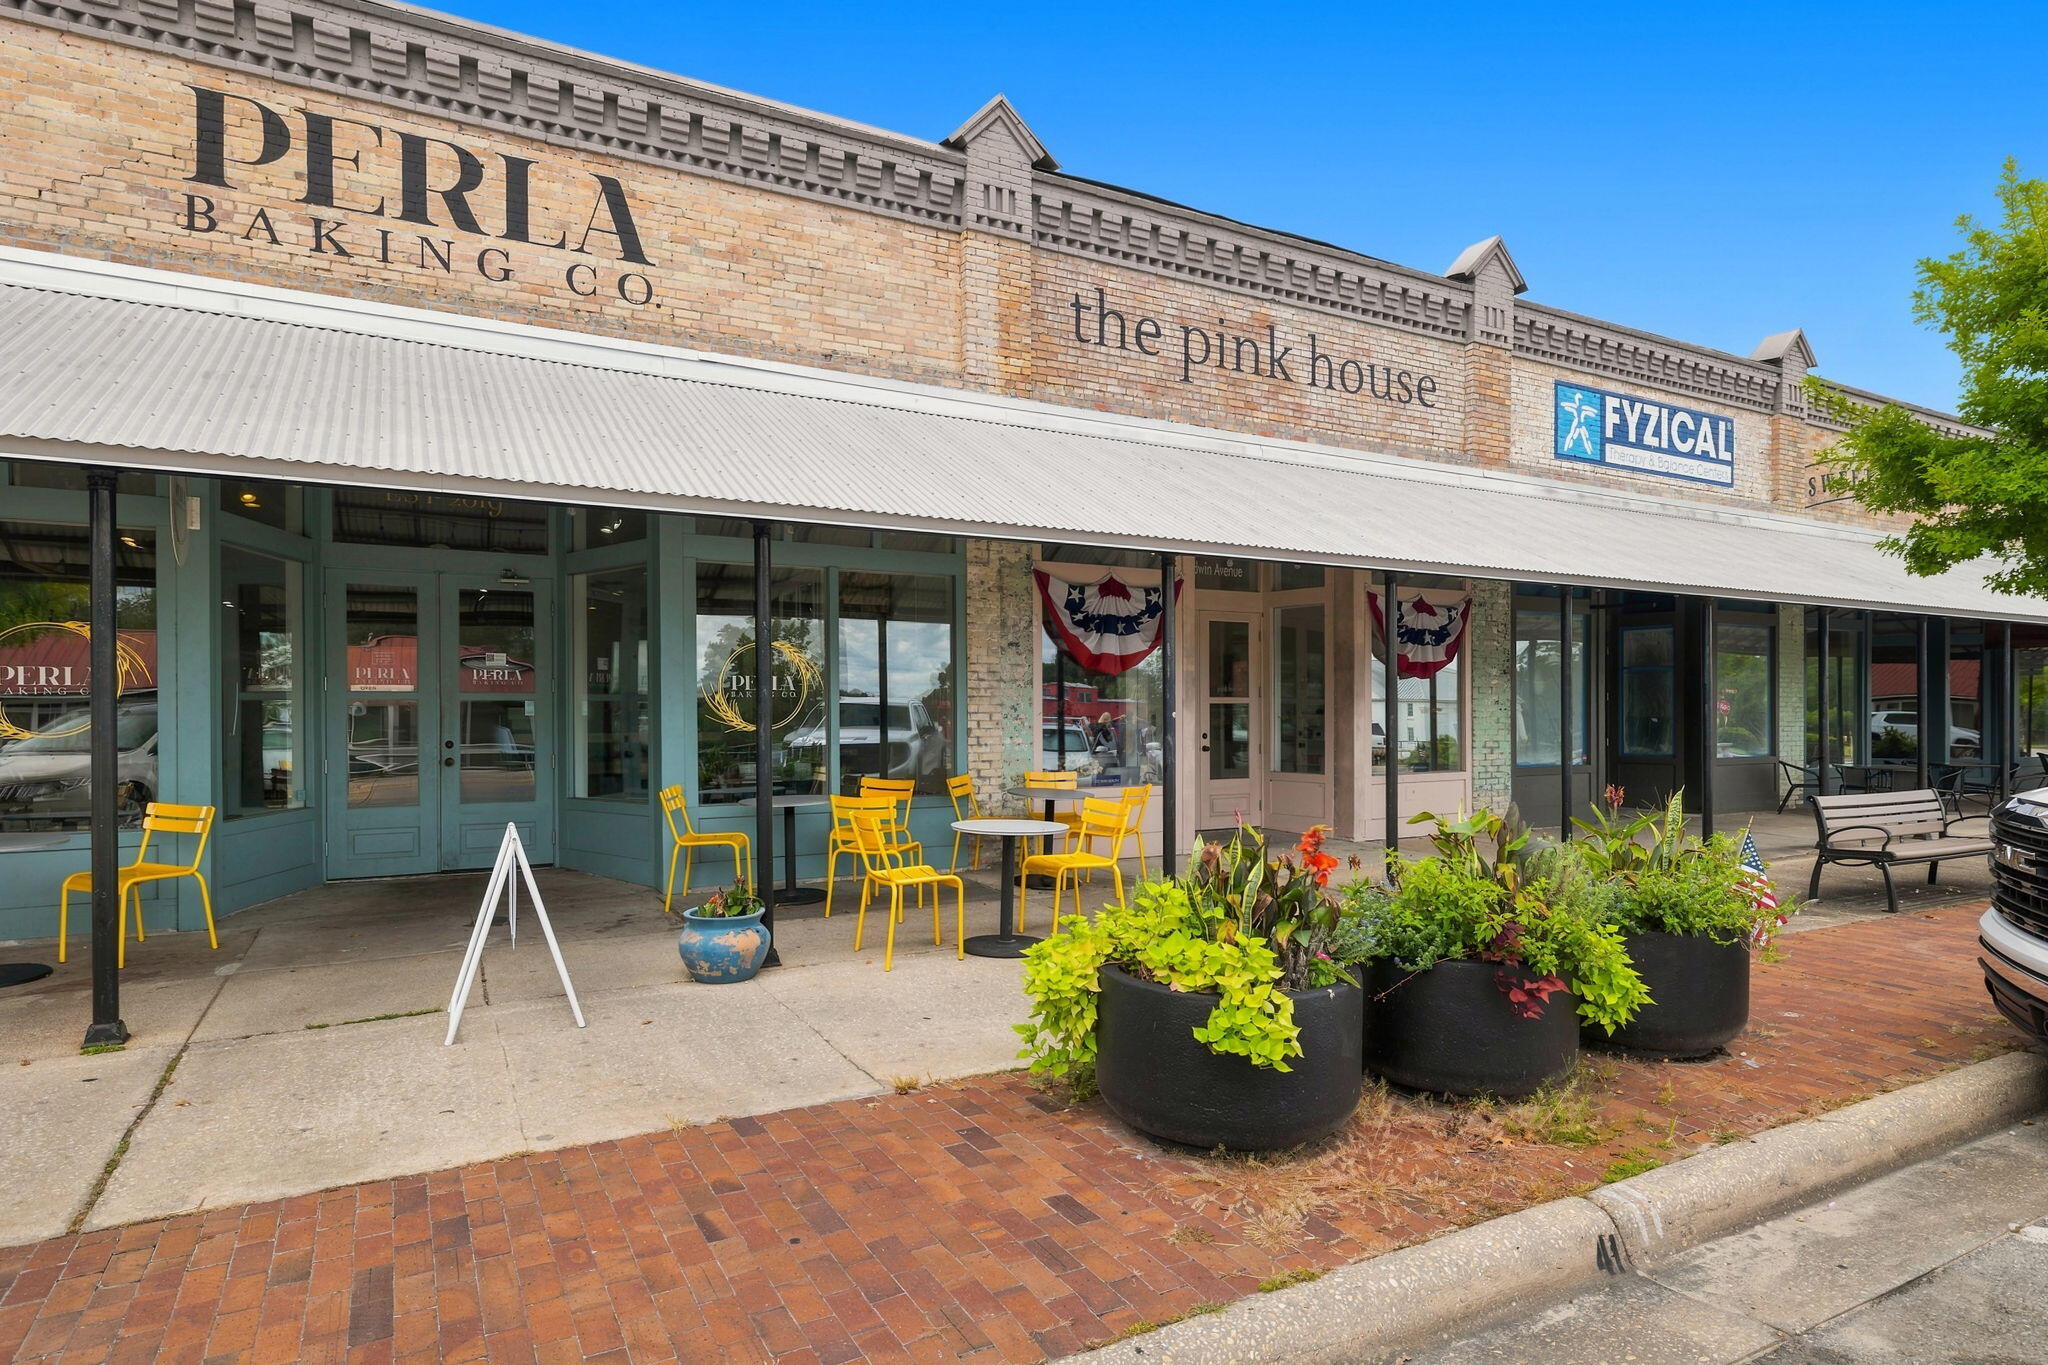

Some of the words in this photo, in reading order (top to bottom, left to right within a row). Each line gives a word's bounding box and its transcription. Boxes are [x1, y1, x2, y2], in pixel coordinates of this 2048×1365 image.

[182, 83, 656, 266] PERLA
[181, 193, 515, 282] BAKING
[1070, 288, 1161, 355] the
[1179, 318, 1294, 383] pink
[1307, 334, 1437, 408] house
[1605, 396, 1732, 461] FYZICAL
[1609, 447, 1646, 466] Therapy
[1648, 454, 1656, 466] &
[1658, 456, 1695, 475] Balance
[1697, 464, 1730, 481] Centers
[1213, 562, 1244, 578] Avenue
[3, 686, 68, 696] AKING
[472, 669, 523, 681] PERLA
[730, 675, 796, 691] PELA
